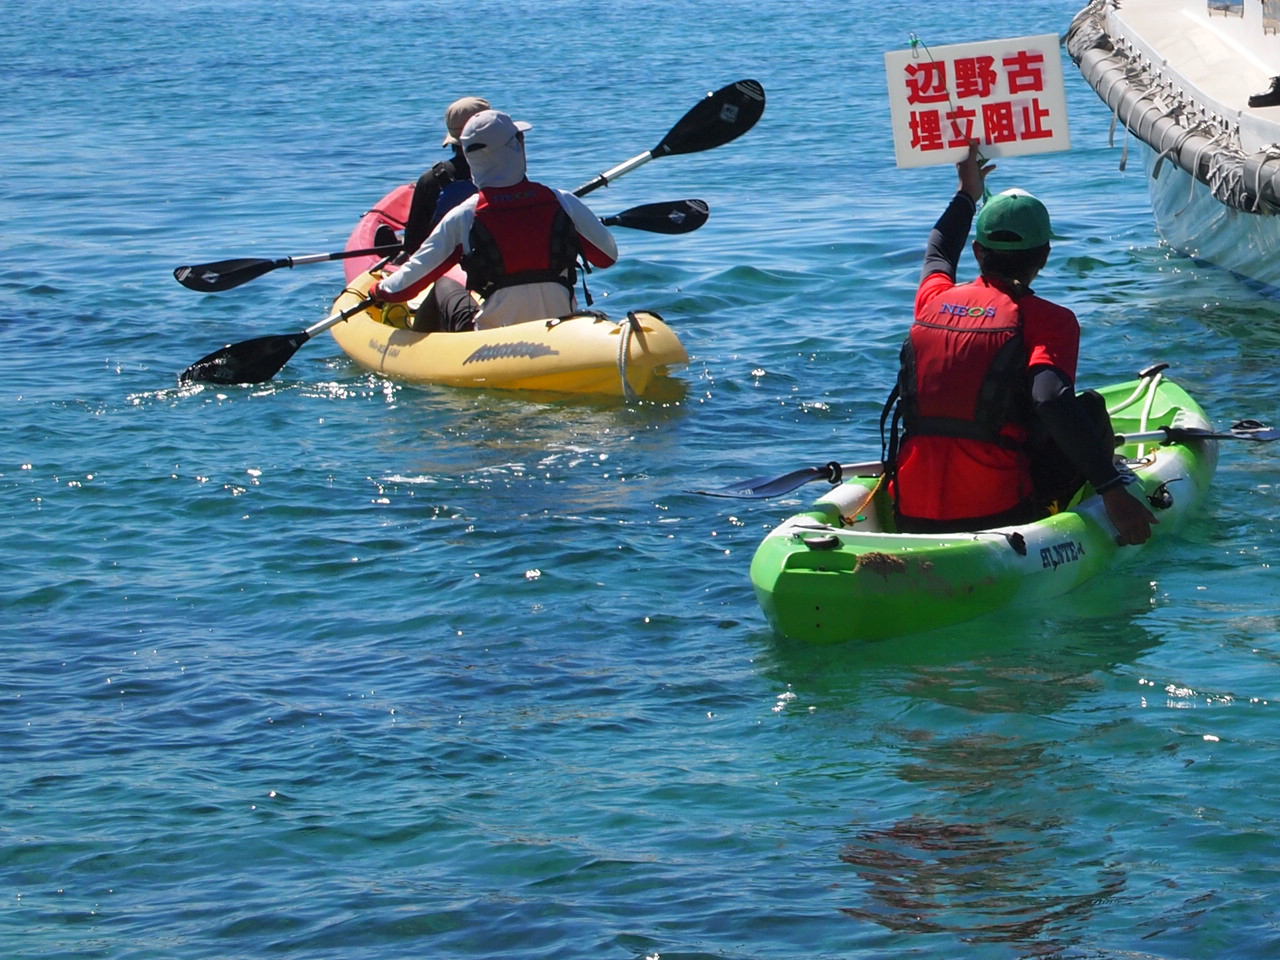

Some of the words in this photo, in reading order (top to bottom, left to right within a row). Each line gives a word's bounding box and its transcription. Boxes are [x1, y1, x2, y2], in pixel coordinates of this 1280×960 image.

[904, 50, 1044, 105] 辺野古
[908, 97, 1053, 152] 埋立阻止
[939, 303, 996, 318] NEOS
